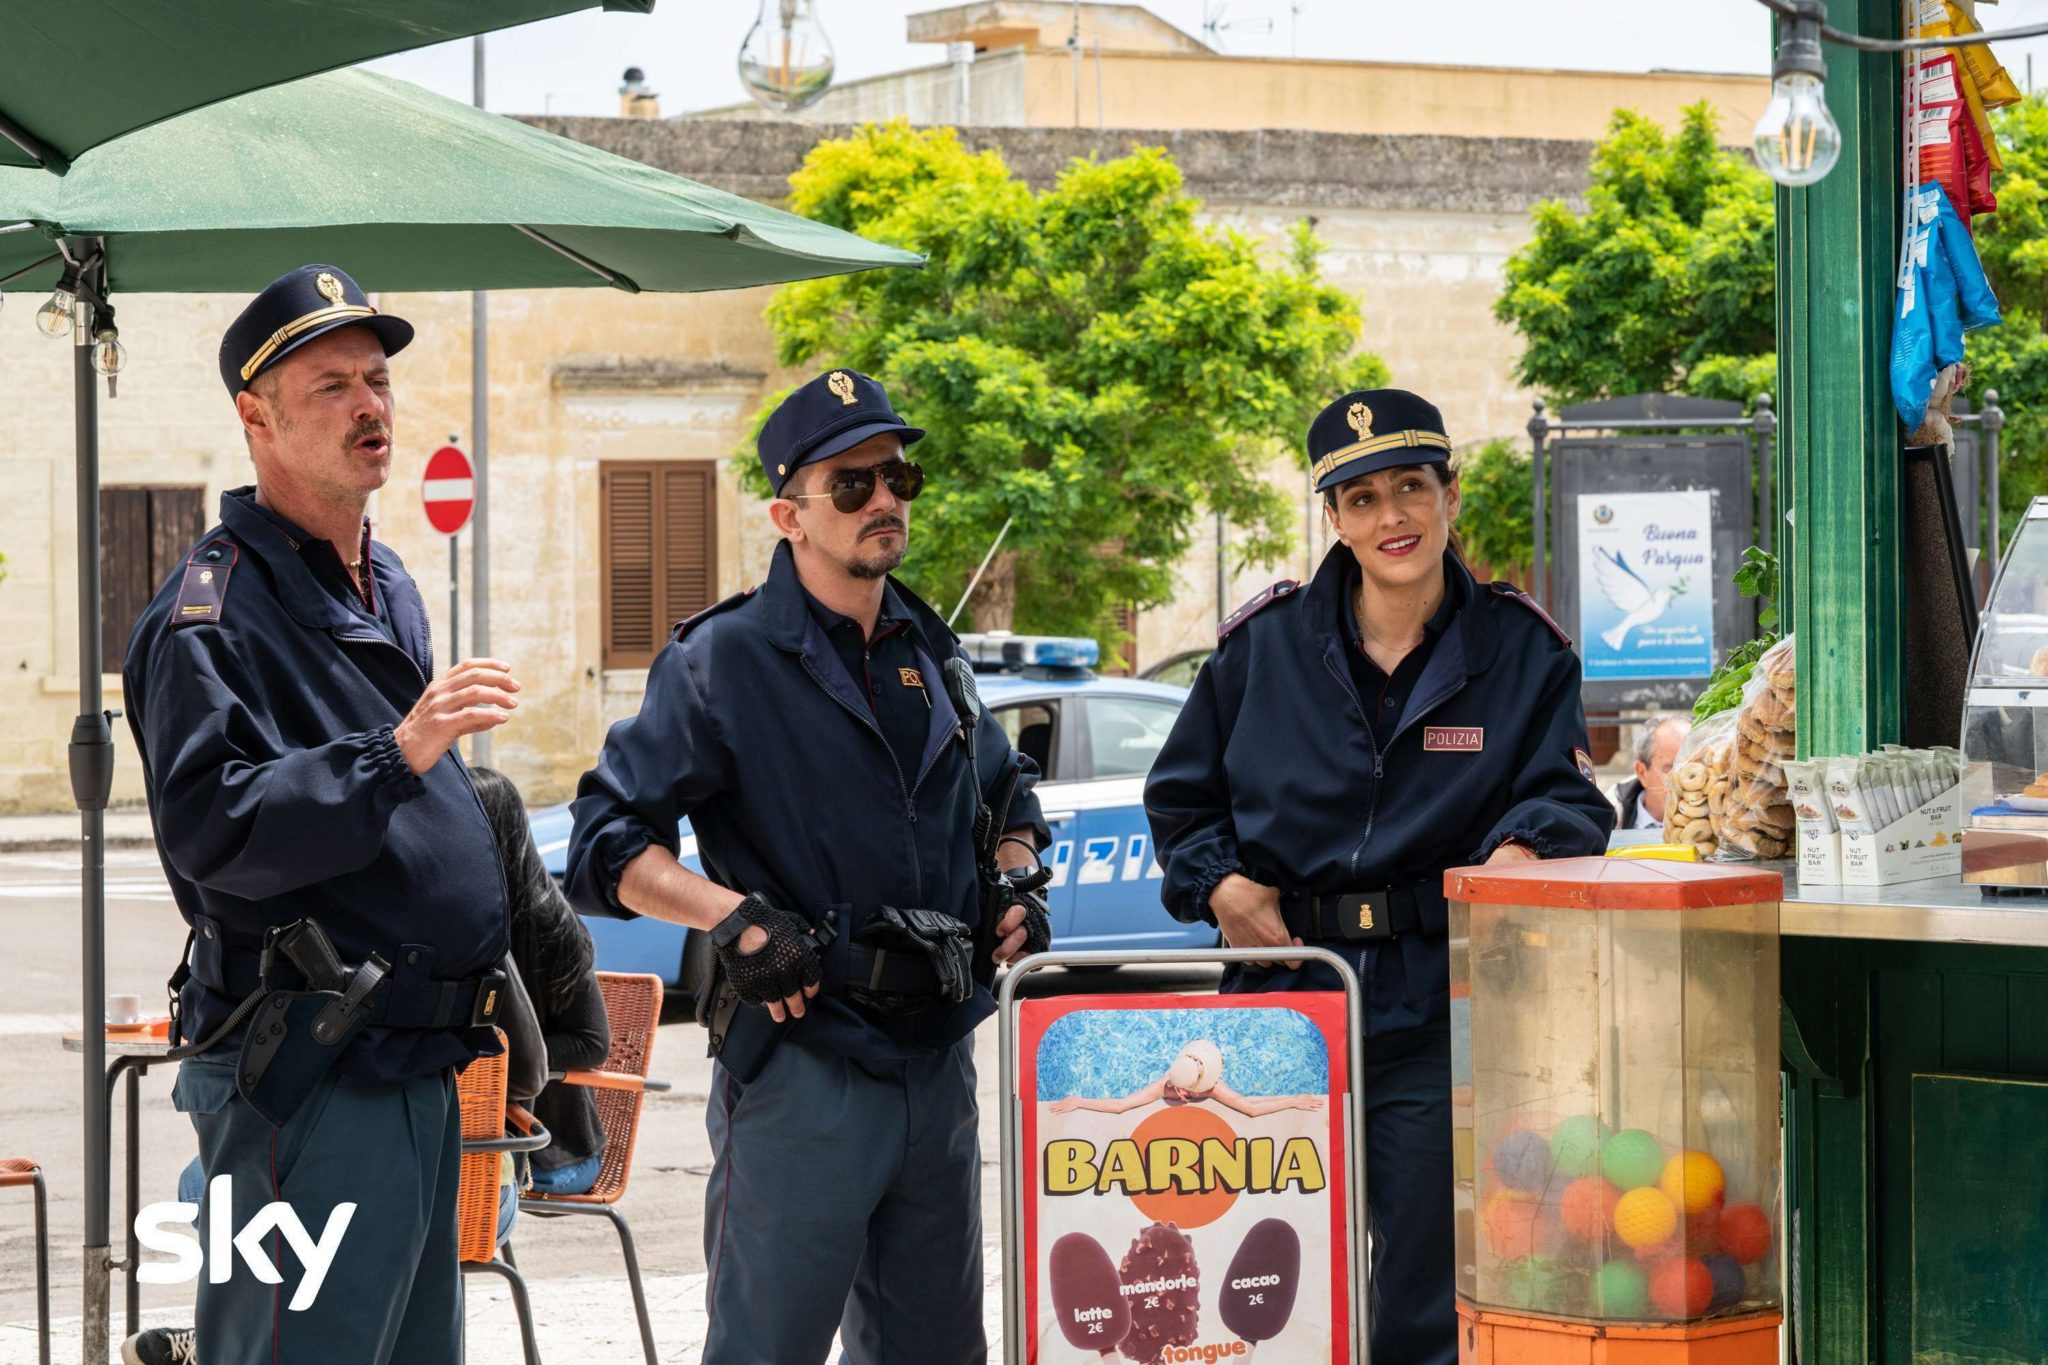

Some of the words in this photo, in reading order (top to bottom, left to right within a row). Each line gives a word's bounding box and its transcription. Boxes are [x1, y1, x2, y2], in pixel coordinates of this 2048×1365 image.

[1643, 523, 1697, 541] Buona
[1642, 548, 1704, 571] Pasqua
[1428, 732, 1479, 745] POLIZIA
[1049, 834, 1165, 888] IZI
[1043, 1136, 1326, 1196] BARNIA
[1119, 1274, 1197, 1296] mandorle
[1231, 1273, 1280, 1291] cacao
[1143, 1296, 1160, 1309] 2€
[1248, 1293, 1264, 1306] 2€
[1074, 1306, 1113, 1323] latte
[1087, 1322, 1104, 1335] 2€
[1163, 1340, 1247, 1365] tongue
